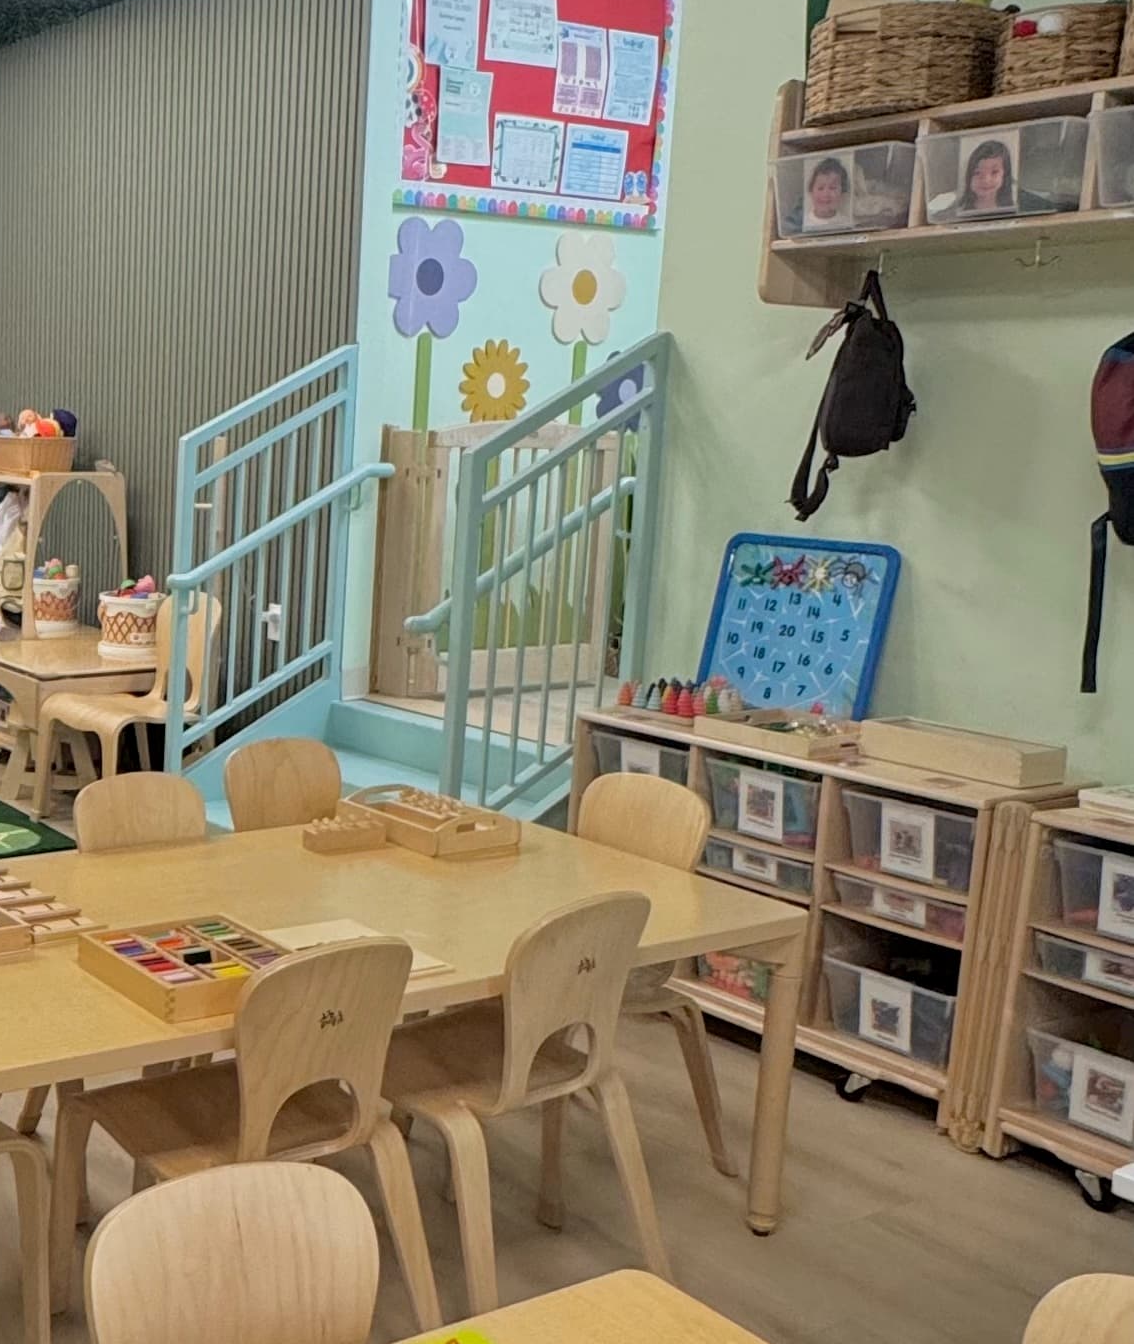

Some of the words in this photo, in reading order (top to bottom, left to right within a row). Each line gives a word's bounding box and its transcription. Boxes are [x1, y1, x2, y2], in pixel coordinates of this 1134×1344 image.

[737, 599, 747, 610] 11
[789, 592, 802, 605] 13
[832, 594, 842, 607] 4
[764, 599, 778, 611] 12
[807, 606, 821, 619] 14
[751, 621, 764, 633] 19
[778, 624, 796, 637] 20
[727, 632, 739, 644] 10
[810, 630, 825, 643] 15
[840, 629, 850, 642] 5
[753, 646, 766, 659] 18
[797, 654, 811, 666] 16
[737, 666, 745, 678] 9
[772, 661, 786, 673] 17
[824, 663, 833, 675] 6
[763, 687, 772, 699] 8
[796, 685, 807, 696] 7
